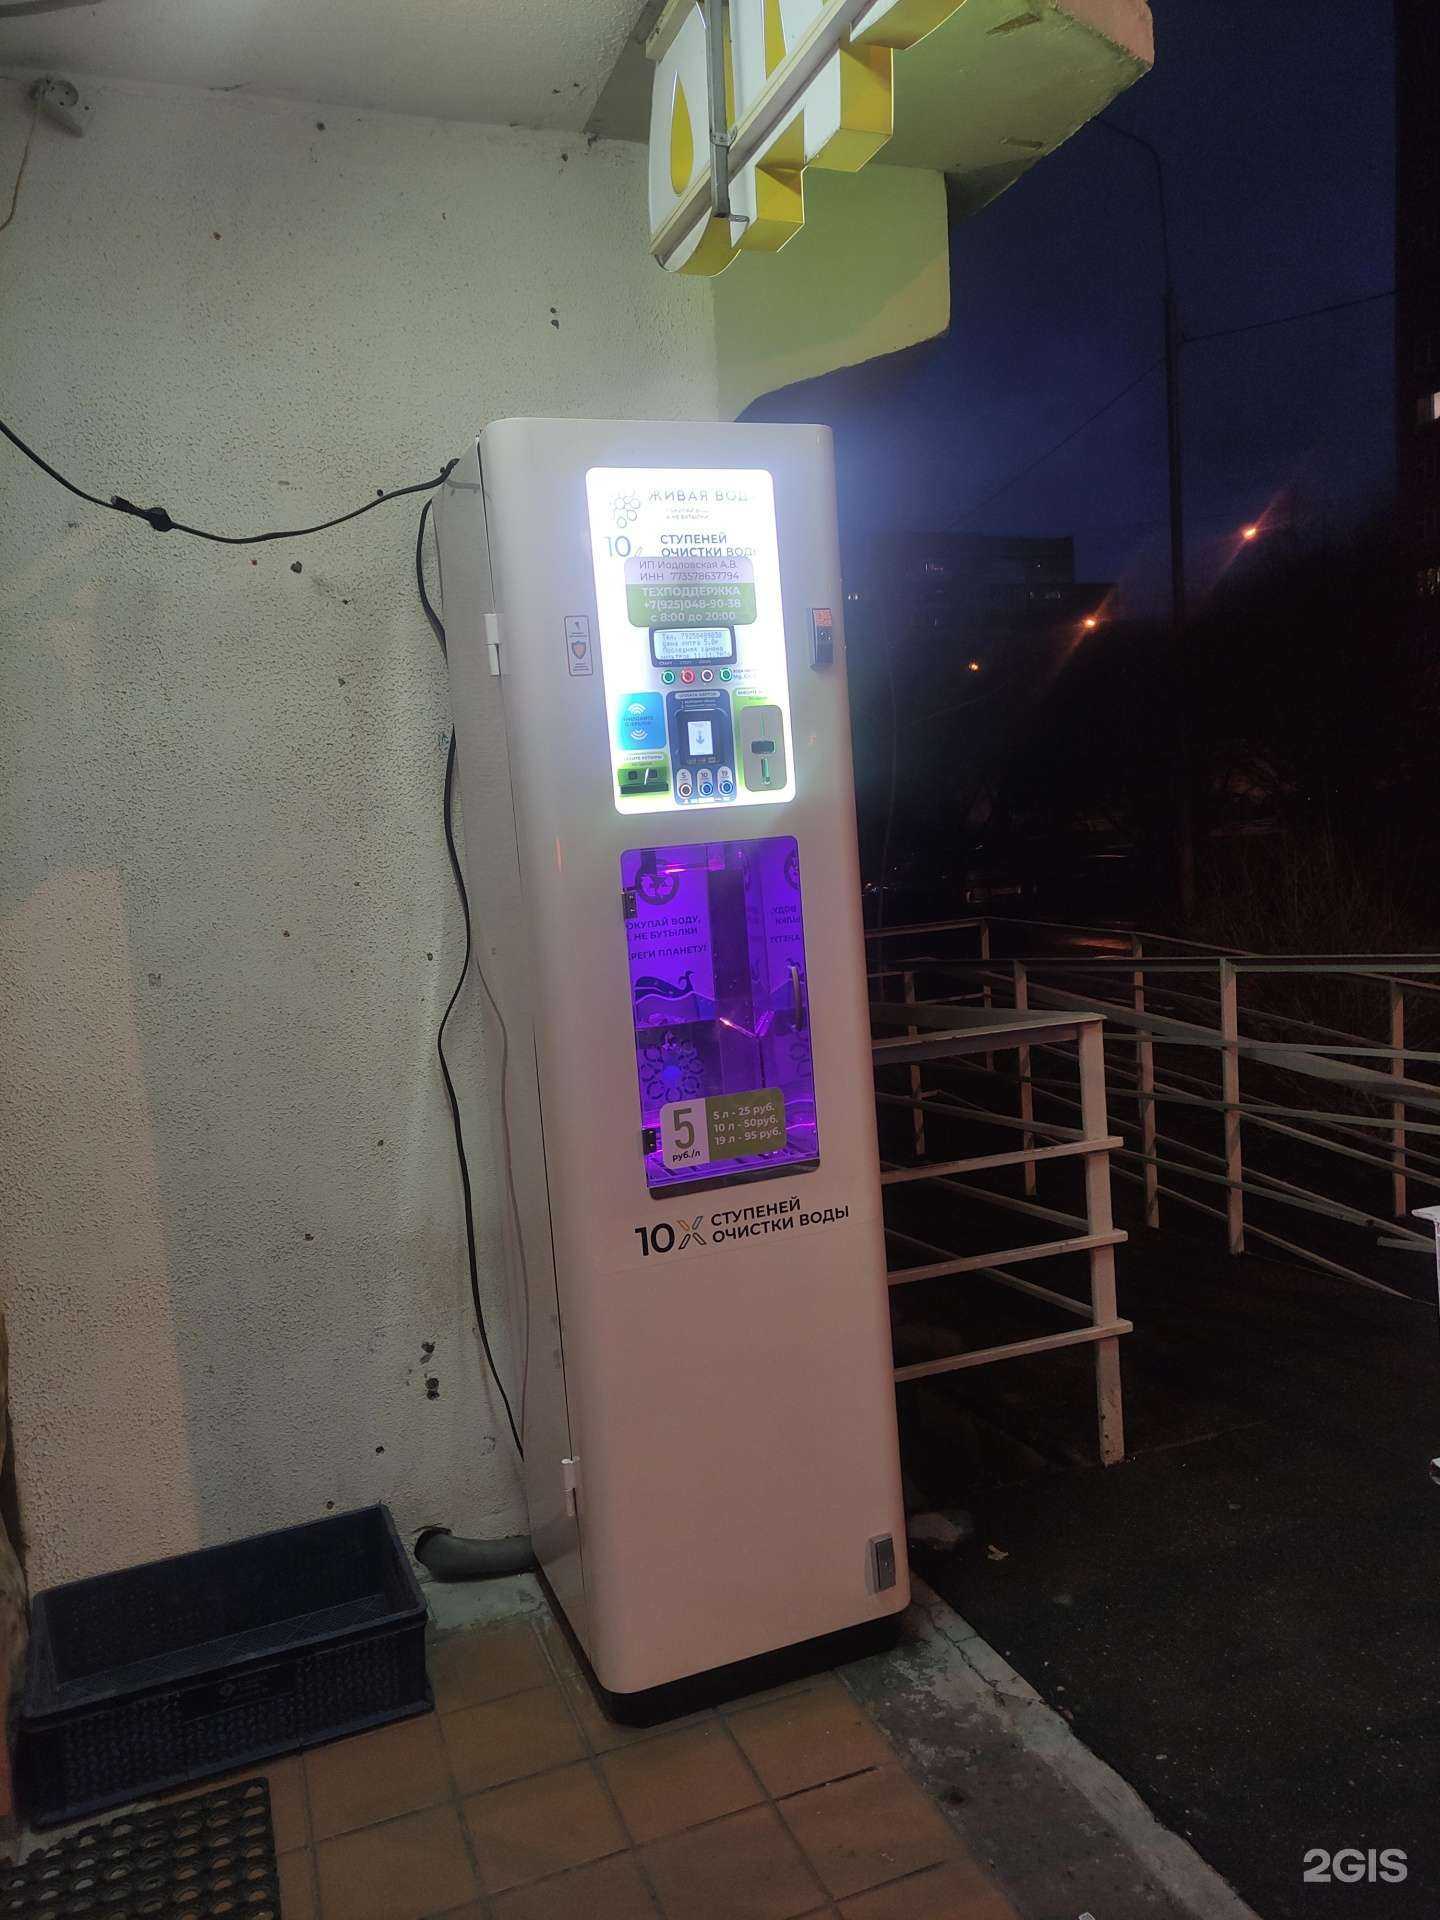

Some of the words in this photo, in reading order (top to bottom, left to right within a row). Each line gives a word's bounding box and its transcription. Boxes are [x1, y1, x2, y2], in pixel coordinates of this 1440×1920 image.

[648, 490, 708, 502] ЖИВАЯ
[715, 489, 756, 502] ВОД
[660, 533, 727, 545] СТУПЕНЕЙ
[661, 547, 722, 558] ОЧИСТКИ
[726, 547, 756, 557] ВОД
[639, 560, 655, 570] ИП
[640, 573, 664, 582] ИНН
[641, 586, 741, 598] ТЕХПОДДЕРЖКА
[687, 614, 702, 623] до
[704, 611, 736, 622] 20:00
[626, 917, 669, 930] ОКУПАЙ
[650, 927, 698, 940] БУТЫЛКИ
[713, 1111, 720, 1120] 5
[722, 1111, 729, 1119] л
[738, 1106, 751, 1116] 25
[753, 1102, 775, 1116] руб.
[672, 1107, 695, 1150] 5
[714, 1123, 725, 1133] 10
[714, 1135, 726, 1145] 19
[745, 1131, 758, 1142] 95
[759, 1128, 782, 1141] руб.
[671, 1150, 701, 1162] руб./л
[711, 1195, 801, 1227] СТУПЕНЕЙ
[712, 1217, 794, 1243] ОЧИСТКИ
[800, 1205, 849, 1227] ВОДЫ
